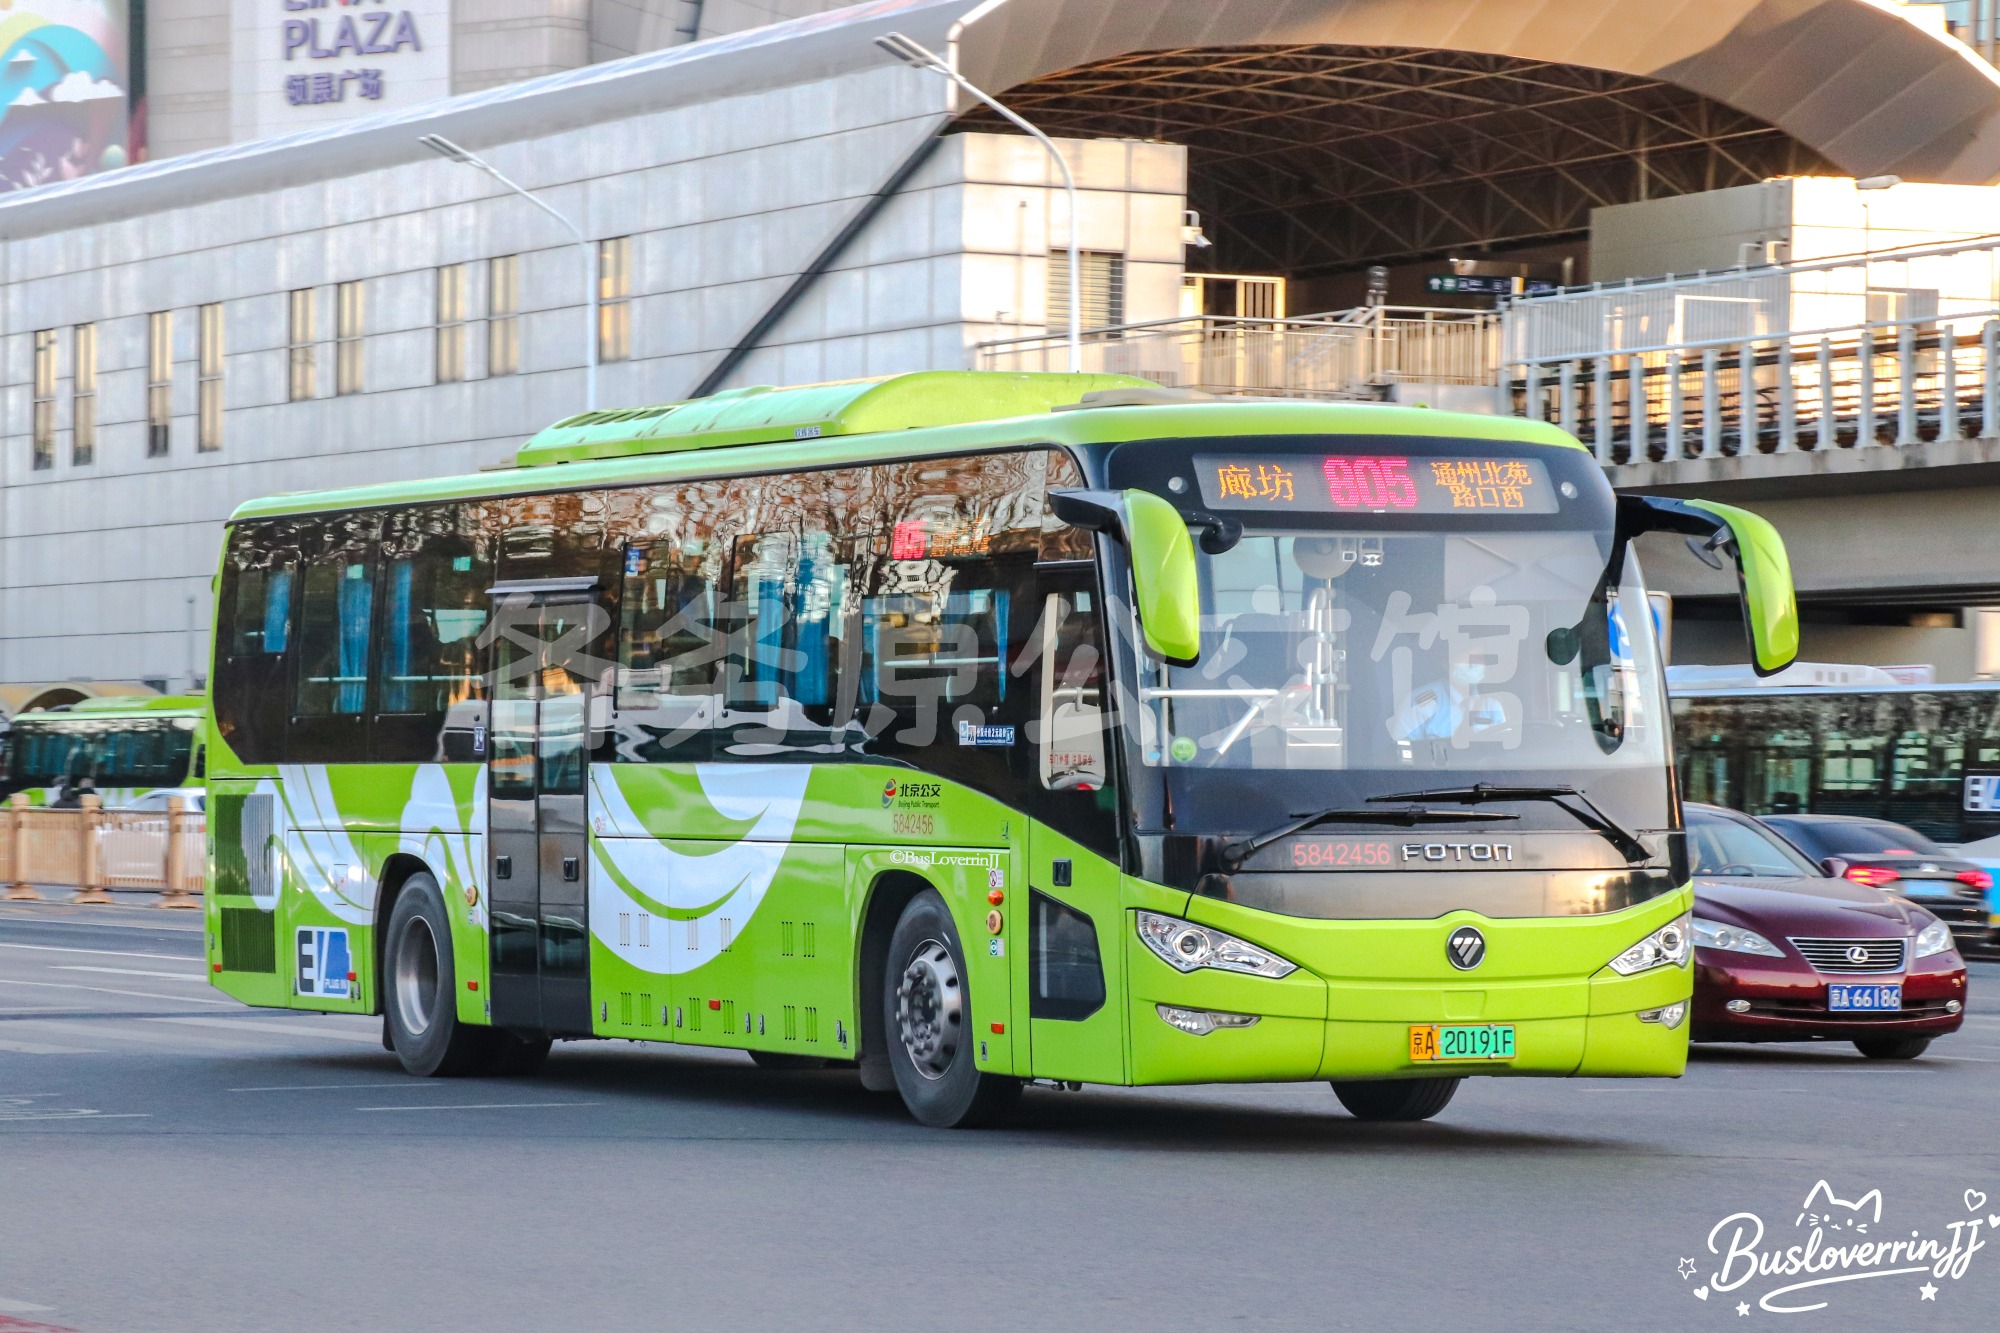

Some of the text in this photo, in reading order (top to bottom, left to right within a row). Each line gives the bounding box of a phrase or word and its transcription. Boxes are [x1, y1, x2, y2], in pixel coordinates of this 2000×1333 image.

[284, 10, 421, 60] PLAZA
[1217, 458, 1534, 508] 廊坊 805 通州北苑
[1449, 486, 1525, 508] 路口西
[899, 783, 942, 797] 北京公交
[898, 800, 940, 810] Beijing Public Transport
[893, 813, 934, 835] 5842456
[1293, 843, 1513, 866] 5842456 FOTON
